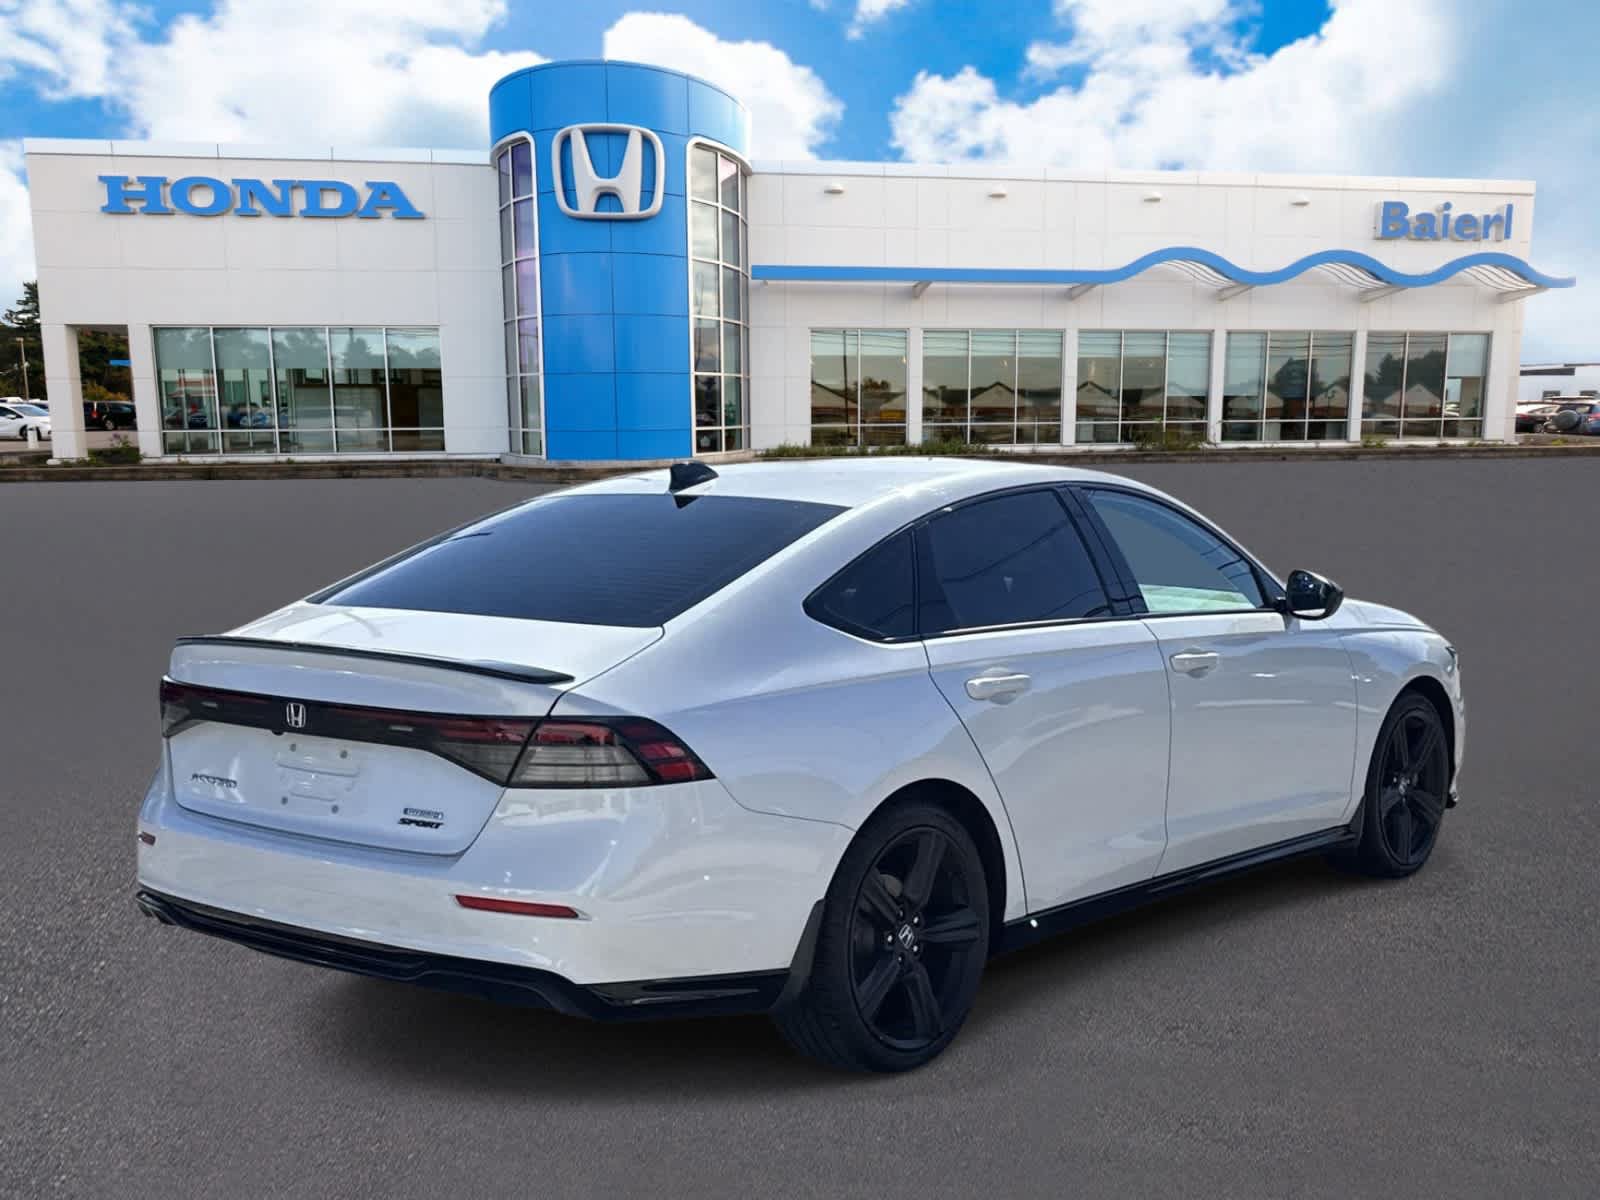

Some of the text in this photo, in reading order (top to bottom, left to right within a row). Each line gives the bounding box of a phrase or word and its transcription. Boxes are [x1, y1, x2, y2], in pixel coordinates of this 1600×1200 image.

[98, 175, 425, 219] HONDA
[1379, 200, 1514, 241] Baierl
[397, 817, 444, 829] SPORT
